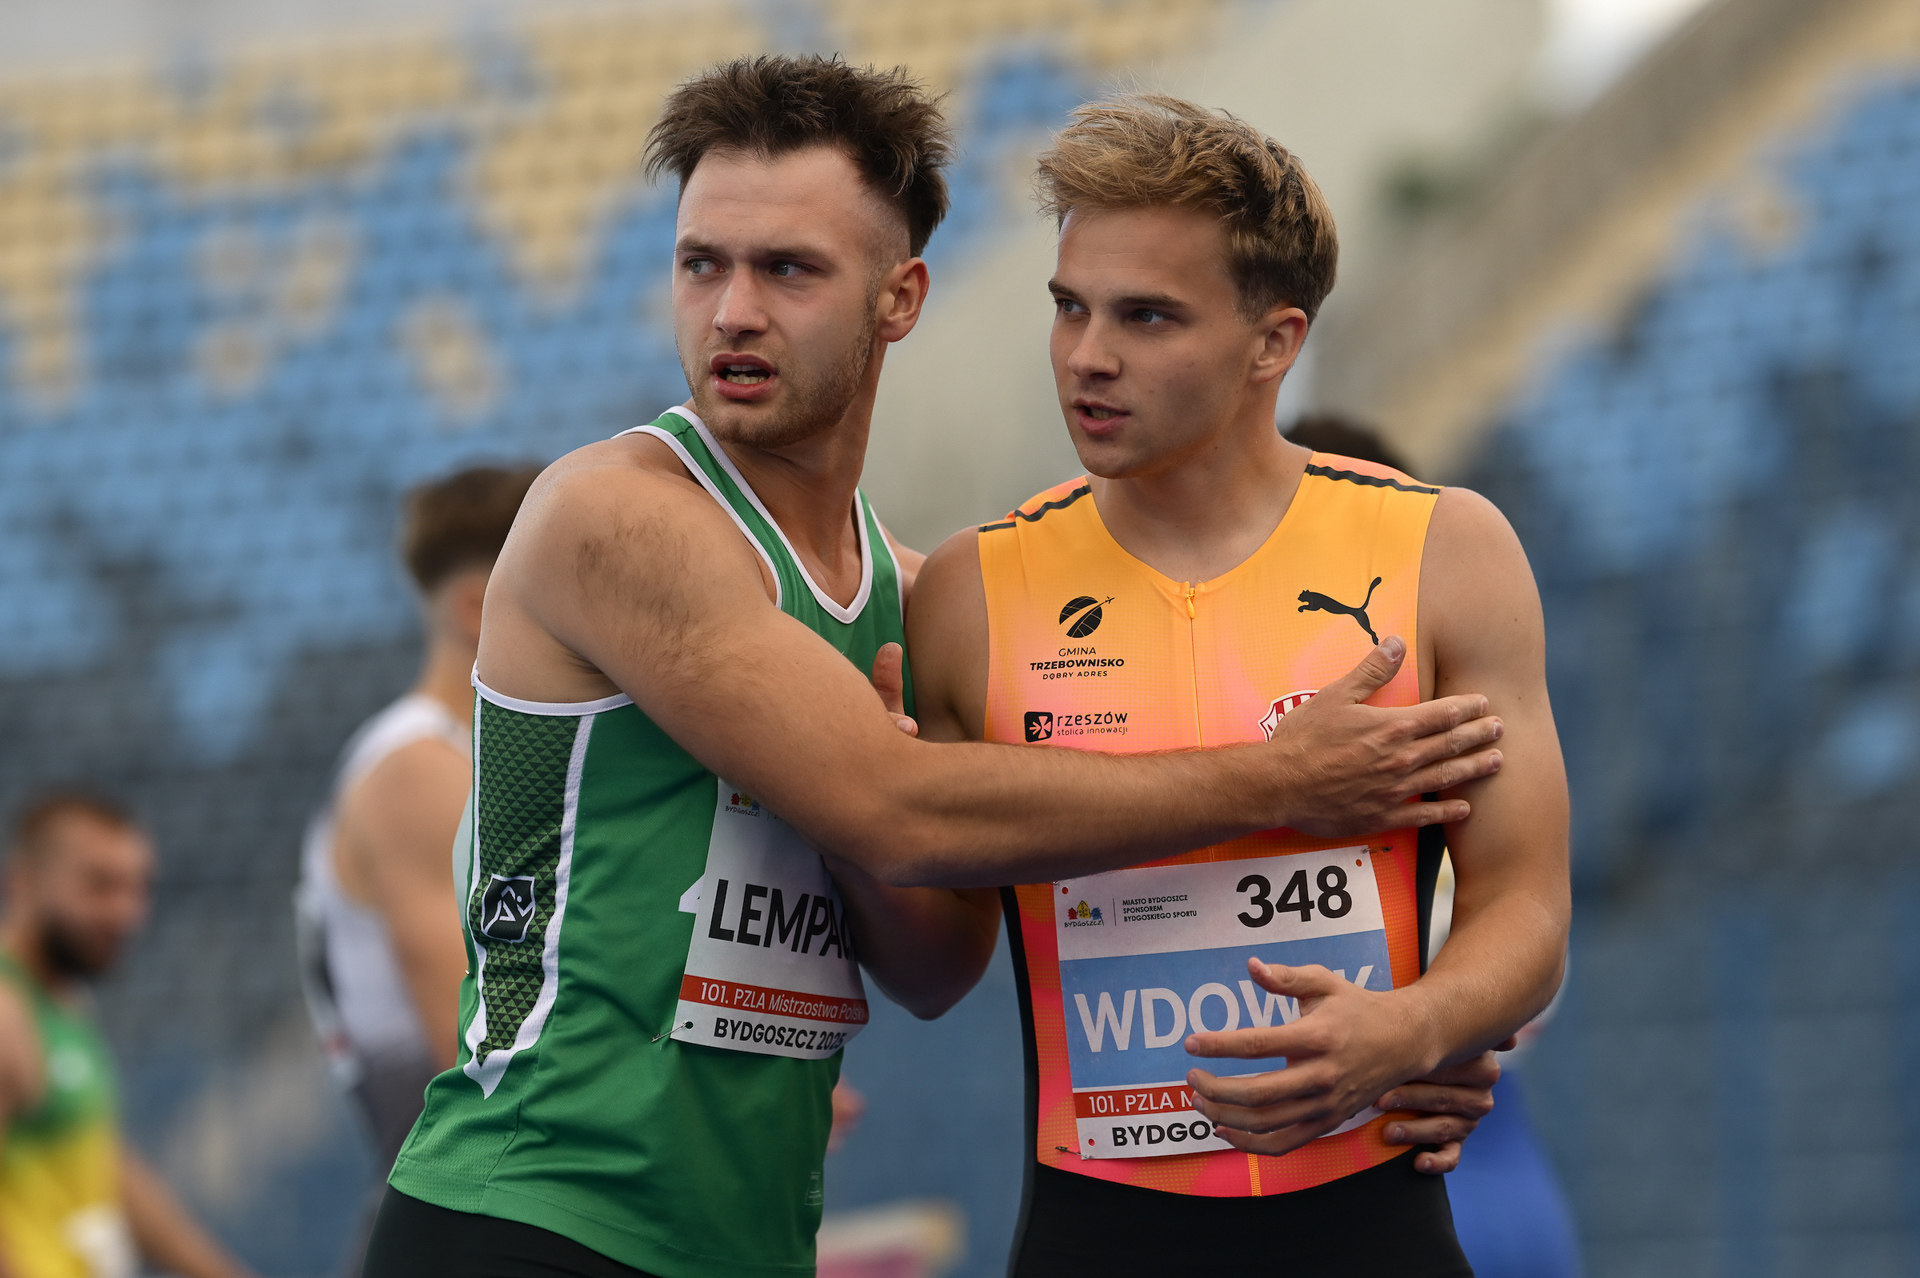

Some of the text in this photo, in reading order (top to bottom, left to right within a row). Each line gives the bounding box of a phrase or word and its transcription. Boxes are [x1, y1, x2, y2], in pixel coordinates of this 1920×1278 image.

[1058, 647, 1097, 657] GMINA
[1029, 658, 1125, 671] TRZEBOWNISKO
[1042, 670, 1108, 680] DOBRY ADRES
[1057, 711, 1128, 727] rzeszów
[1056, 726, 1128, 736] stolica innowacji
[1122, 894, 1188, 906] MIASTO BYDGOSZCZ
[1235, 865, 1353, 928] 348
[1122, 905, 1163, 914] SPONSOREM
[1123, 910, 1198, 922] BYDGOSKIEGO SPORTU
[708, 878, 857, 962] LEMPAC
[1064, 920, 1104, 928] BYDGOSZCZ
[700, 981, 866, 1021] 101. PZLA Mistrzostwa Polski
[1073, 964, 1375, 1053] WDOW
[713, 1017, 848, 1052] BYDGOSZCZ 2025
[1088, 1095, 1120, 1115] 101.
[1125, 1091, 1175, 1113] PZLA
